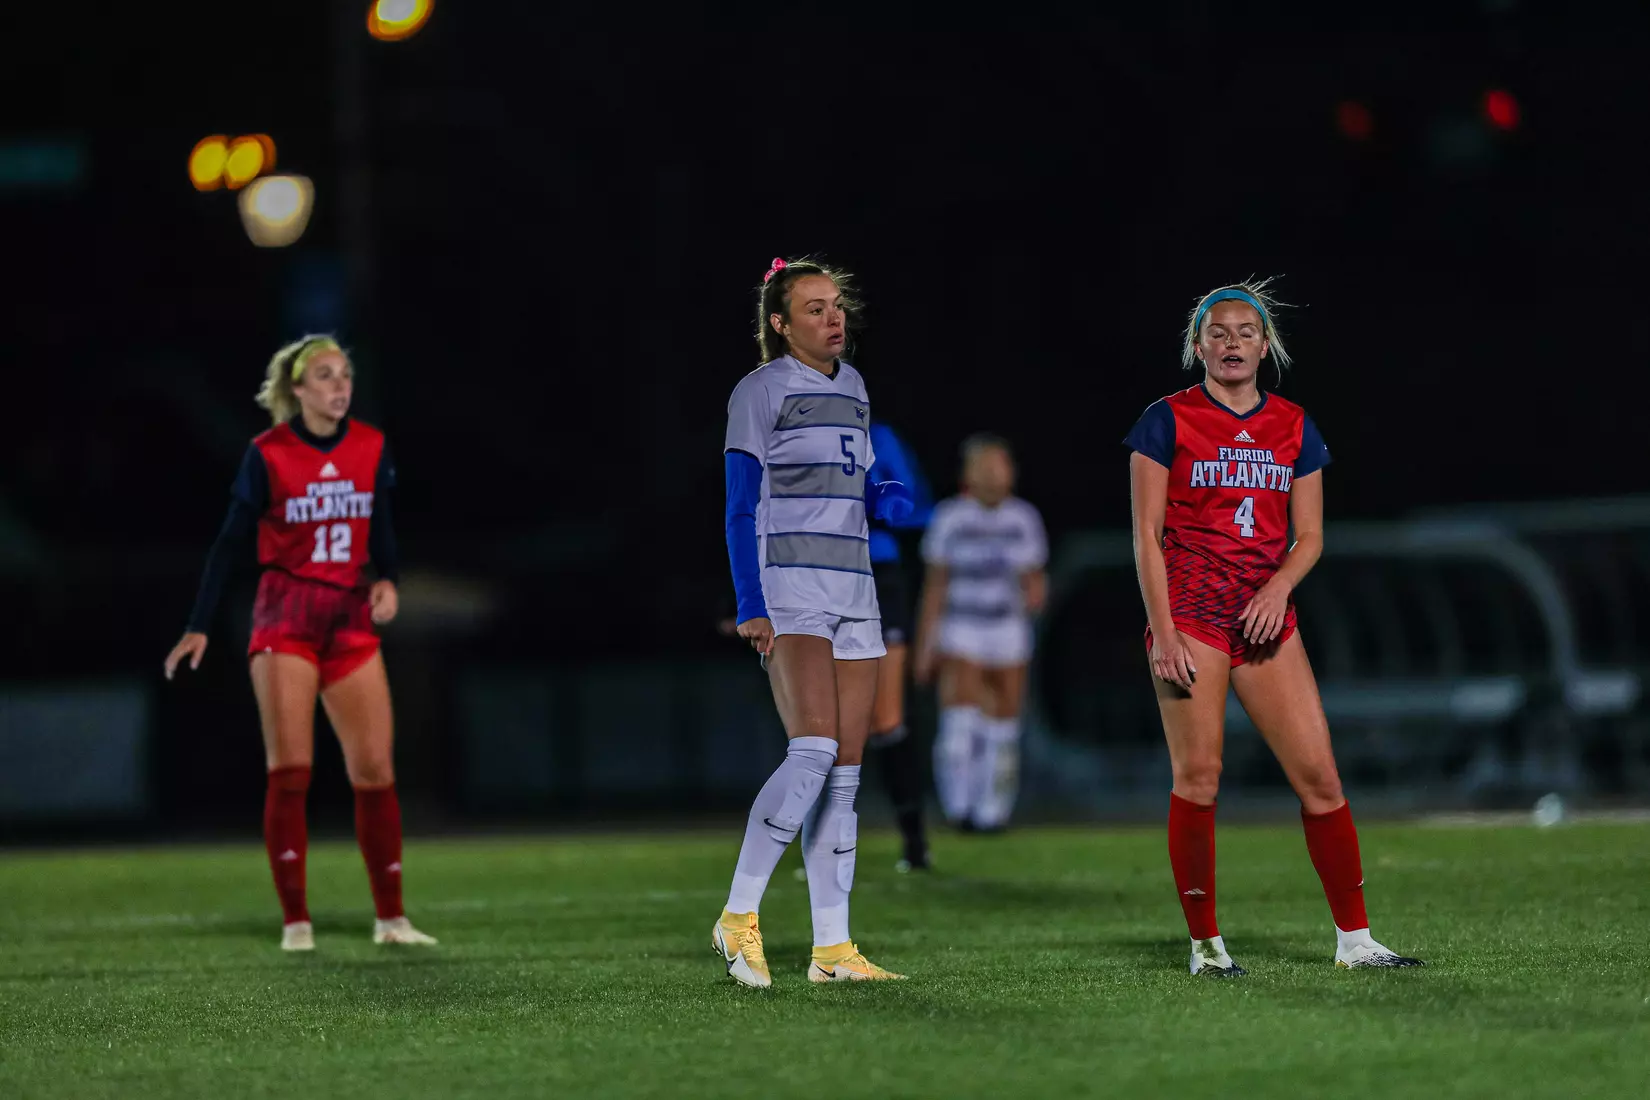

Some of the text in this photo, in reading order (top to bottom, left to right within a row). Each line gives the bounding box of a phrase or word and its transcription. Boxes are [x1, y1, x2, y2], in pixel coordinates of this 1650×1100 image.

[840, 434, 856, 476] 5
[1218, 446, 1275, 463] FLORIDA
[1189, 460, 1294, 493] ATLANTIC
[1233, 495, 1256, 538] 4
[310, 521, 353, 563] 12
